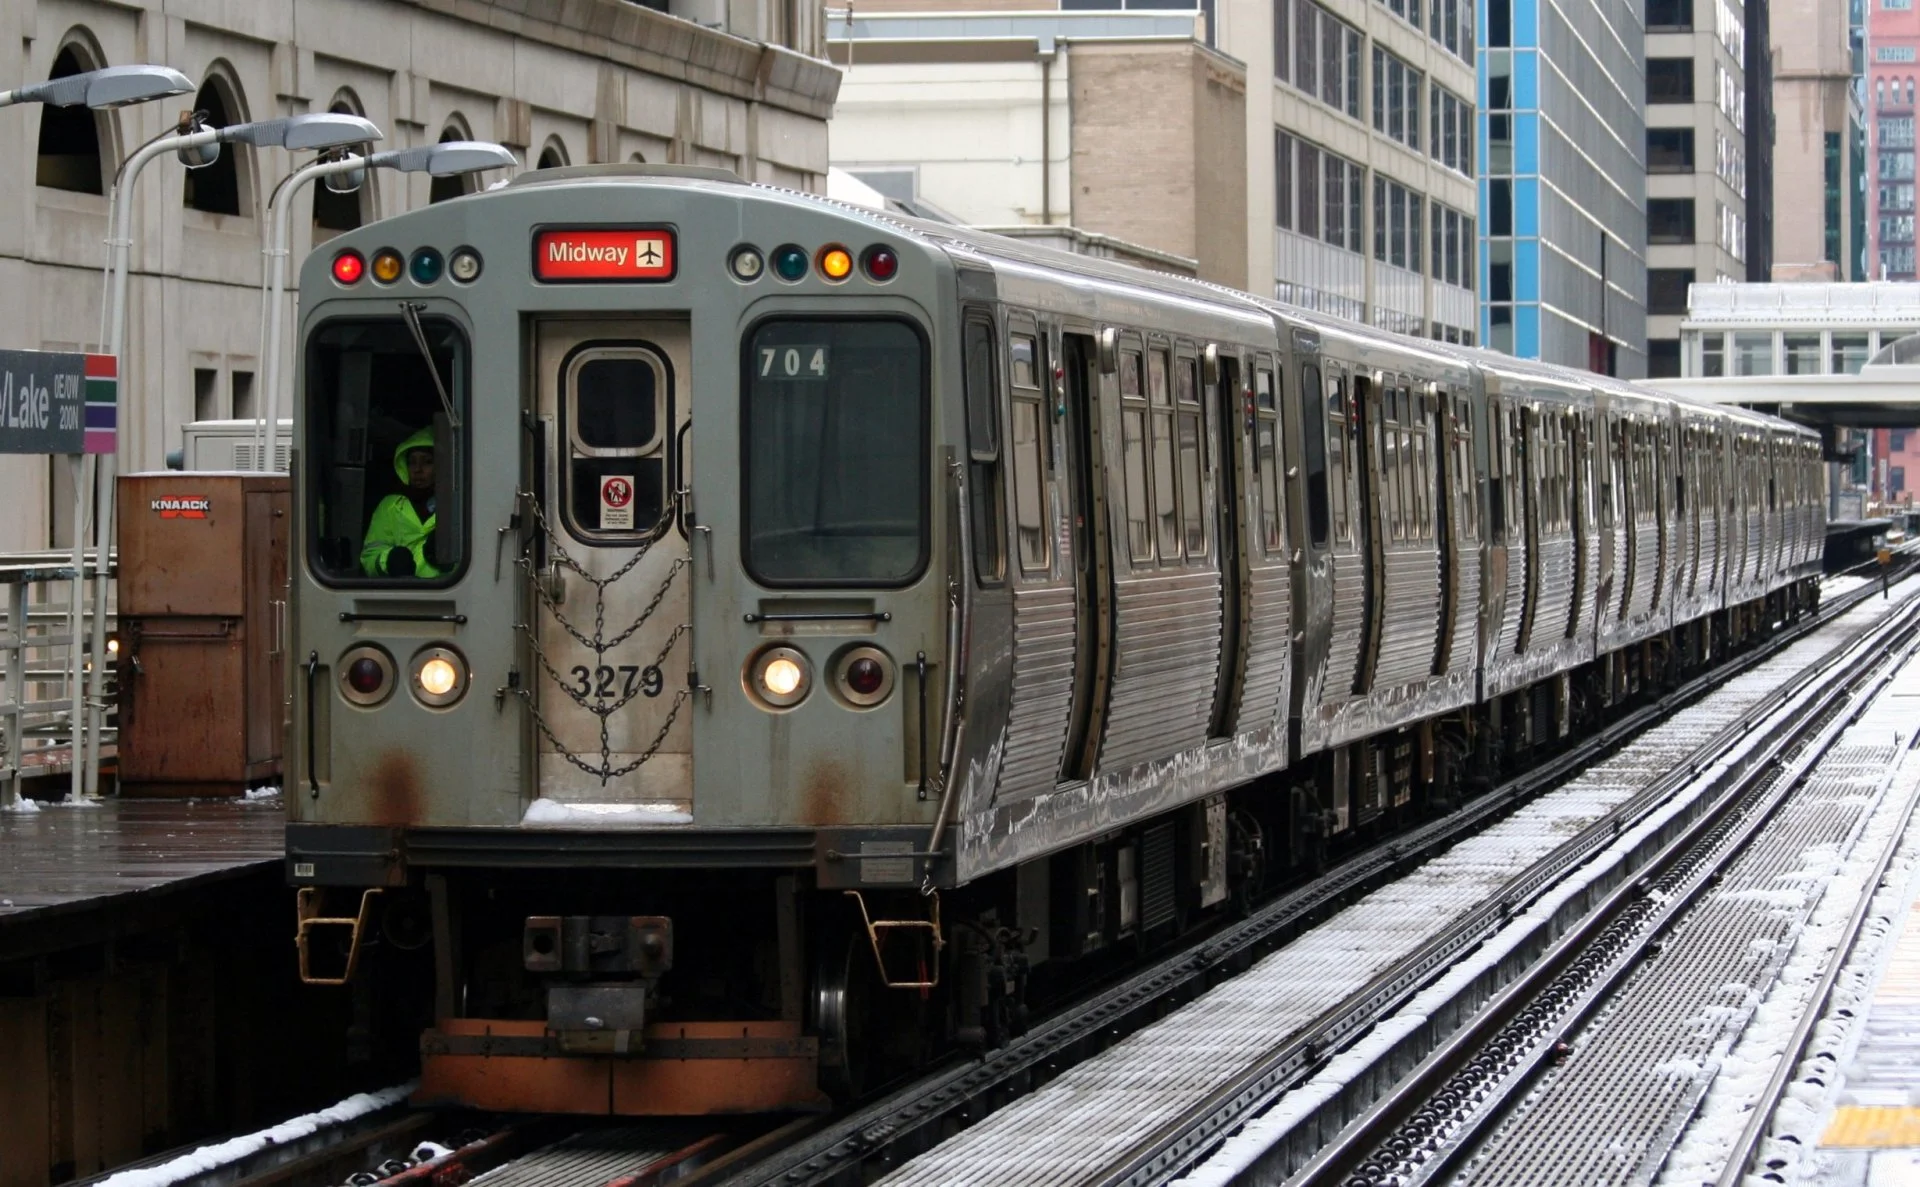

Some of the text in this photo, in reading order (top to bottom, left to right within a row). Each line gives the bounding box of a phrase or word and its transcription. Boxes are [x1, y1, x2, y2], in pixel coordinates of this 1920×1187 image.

[549, 242, 629, 265] Midway
[760, 349, 826, 376] 704
[0, 370, 49, 430] /Lake
[59, 404, 79, 430] 200N
[151, 500, 209, 510] KNAACK
[570, 665, 664, 698] 3279
